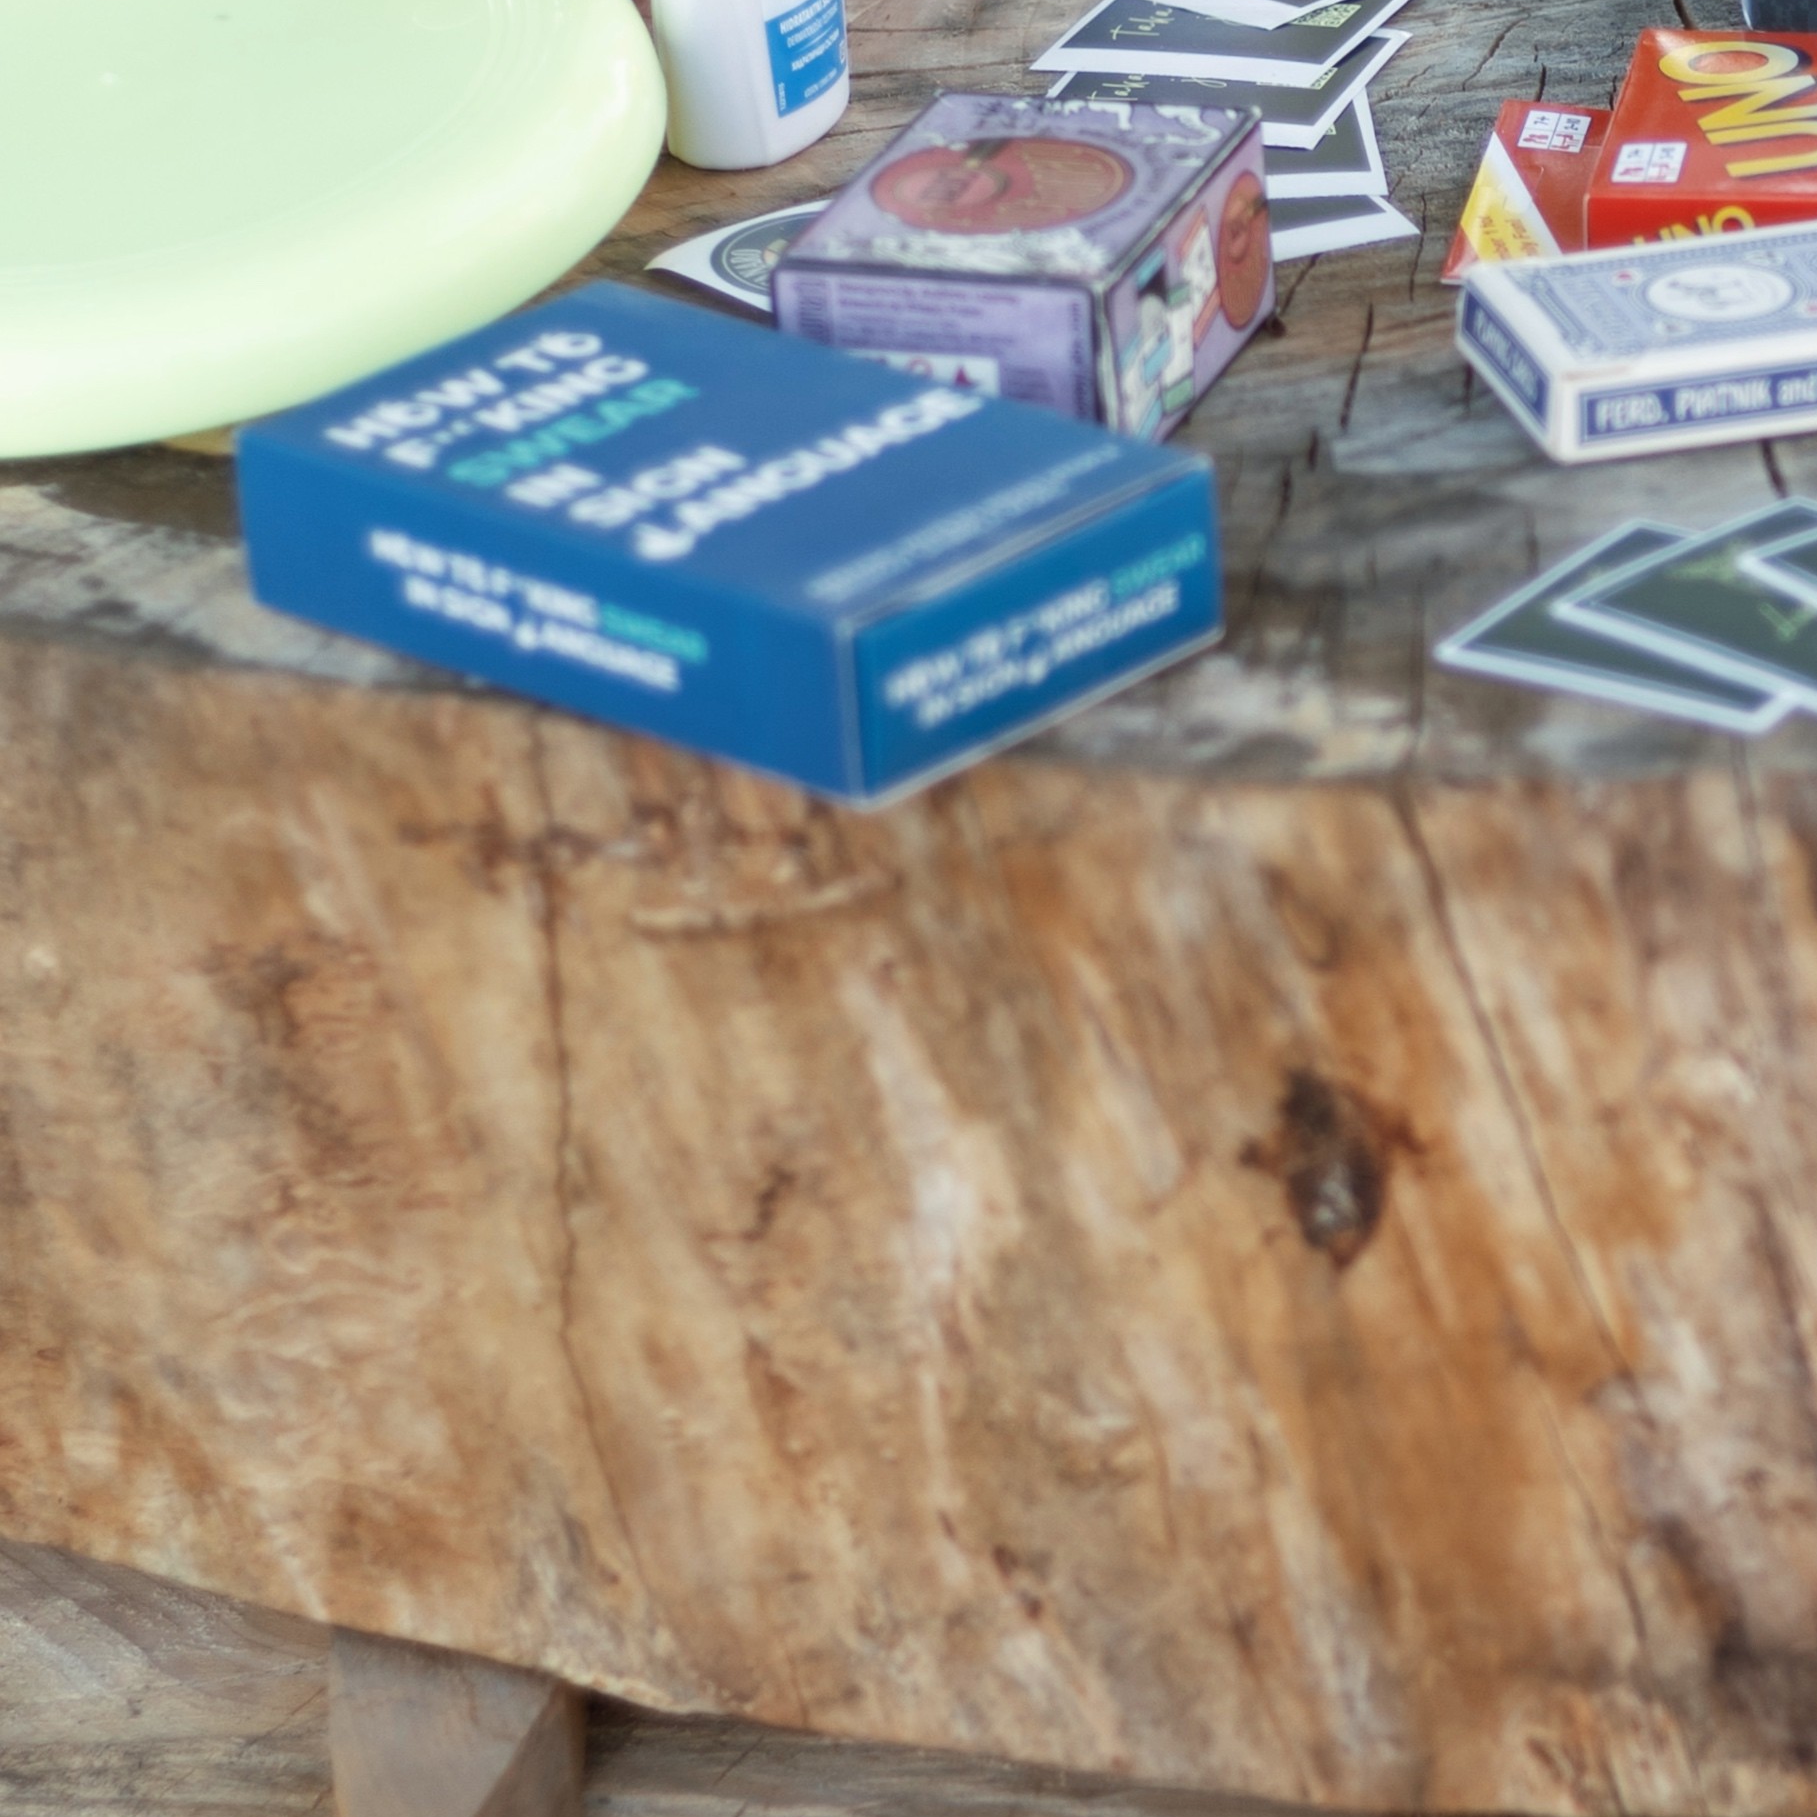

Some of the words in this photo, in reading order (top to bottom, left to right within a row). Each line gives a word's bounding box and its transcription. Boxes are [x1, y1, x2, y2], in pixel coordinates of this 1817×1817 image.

[324, 369, 504, 450] HOW
[495, 332, 603, 373] TO
[447, 378, 699, 485] SWEAR
[1675, 377, 1772, 421] PIATNIK
[506, 463, 603, 508] IN
[569, 445, 746, 528] SIGN
[634, 386, 983, 561] LANGUAGE
